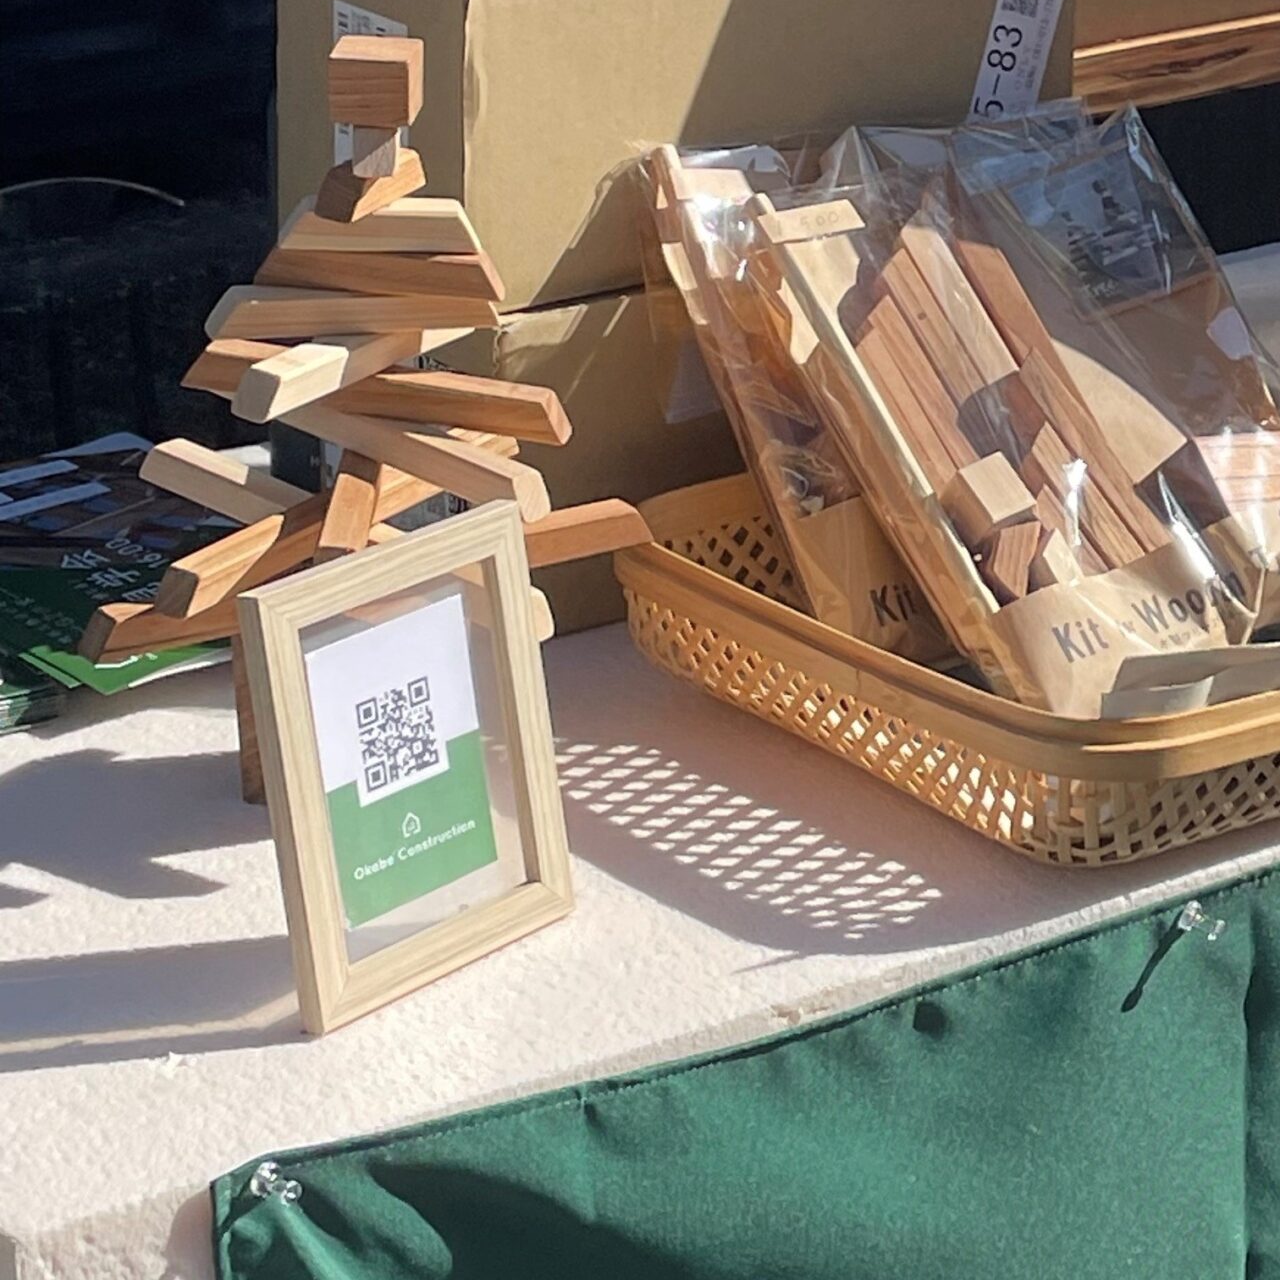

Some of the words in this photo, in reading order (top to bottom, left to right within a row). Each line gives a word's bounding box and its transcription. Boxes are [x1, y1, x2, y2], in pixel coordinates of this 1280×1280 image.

[1052, 617, 1109, 663] Kit
[353, 855, 395, 881] Okabe
[398, 819, 477, 861] Construction
